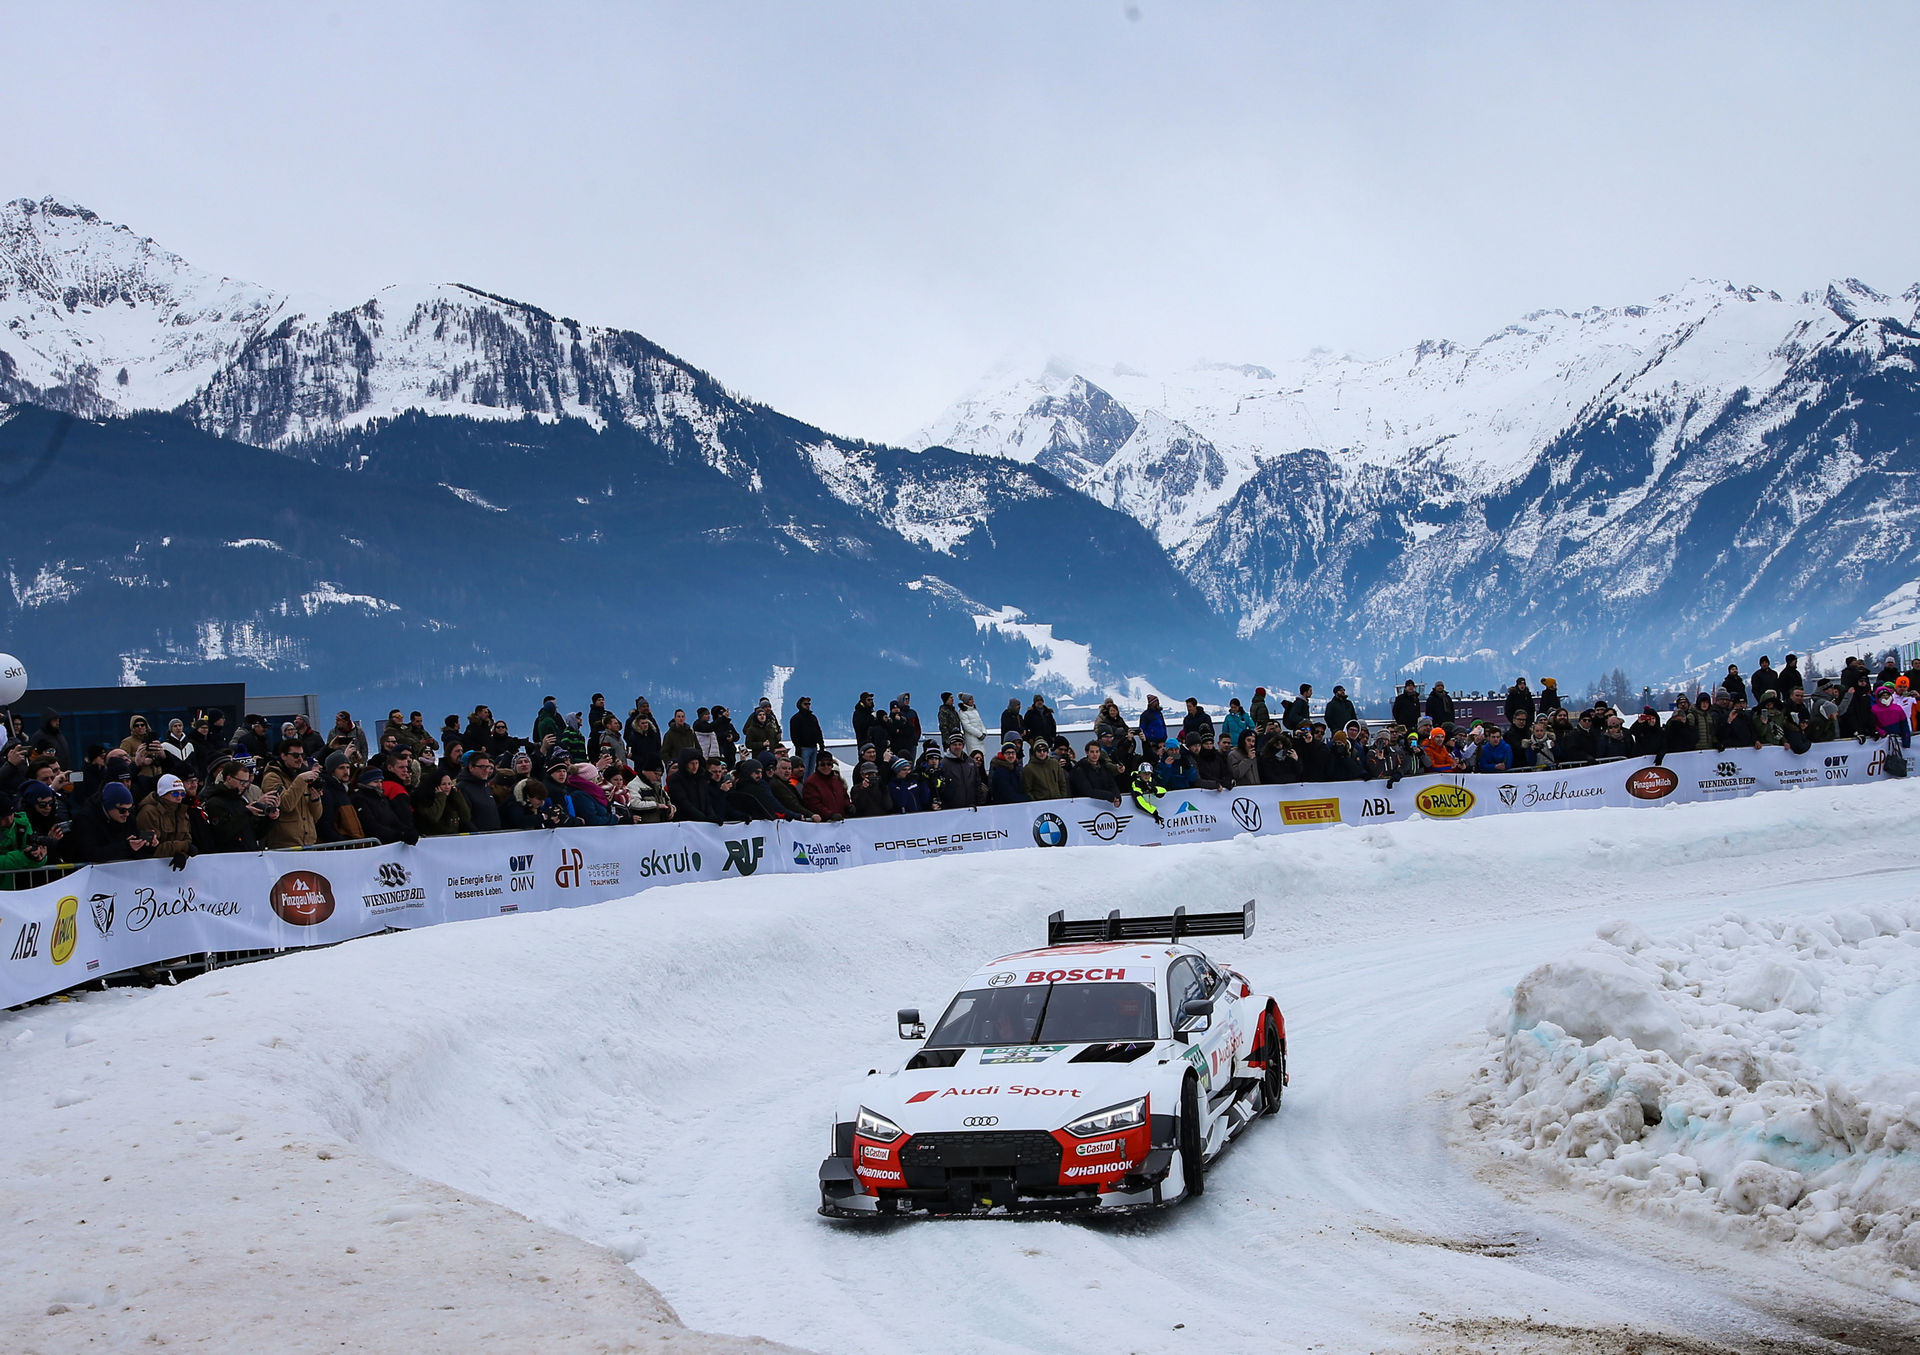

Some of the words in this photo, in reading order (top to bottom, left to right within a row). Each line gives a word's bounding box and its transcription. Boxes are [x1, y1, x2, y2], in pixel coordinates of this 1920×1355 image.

[1783, 769, 1802, 777] Energie
[1825, 768, 1849, 780] OMV
[1633, 780, 1656, 790] Pinzgau
[1655, 778, 1671, 787] Milch
[1698, 778, 1738, 789] WIENINGER
[1738, 777, 1756, 785] BIER
[1431, 794, 1467, 808] RAUCH
[1522, 780, 1606, 808] Backhausen
[1284, 803, 1336, 821] PIRELLI
[1361, 797, 1396, 817] ABL
[1096, 821, 1116, 832] MINI
[1160, 814, 1217, 830] SCHMITTEN
[874, 835, 949, 852] PORSCHE
[951, 829, 1009, 844] DESIGN
[808, 854, 839, 870] Kaprun
[447, 877, 459, 887] Die
[460, 874, 485, 887] Energie
[484, 873, 494, 883] für
[493, 873, 503, 882] ein
[510, 875, 535, 893] OMV
[589, 878, 621, 887] TRAUMWERK
[281, 892, 307, 909] Pinzgau
[305, 891, 327, 905] Milch
[454, 888, 484, 900] besseres
[10, 921, 41, 961] ABL
[1025, 968, 1126, 983] BOSCH
[940, 1085, 1000, 1098] Audi
[1007, 1085, 1082, 1098] Sport
[870, 1148, 887, 1159] Castrol
[1086, 1141, 1114, 1154] Castrol
